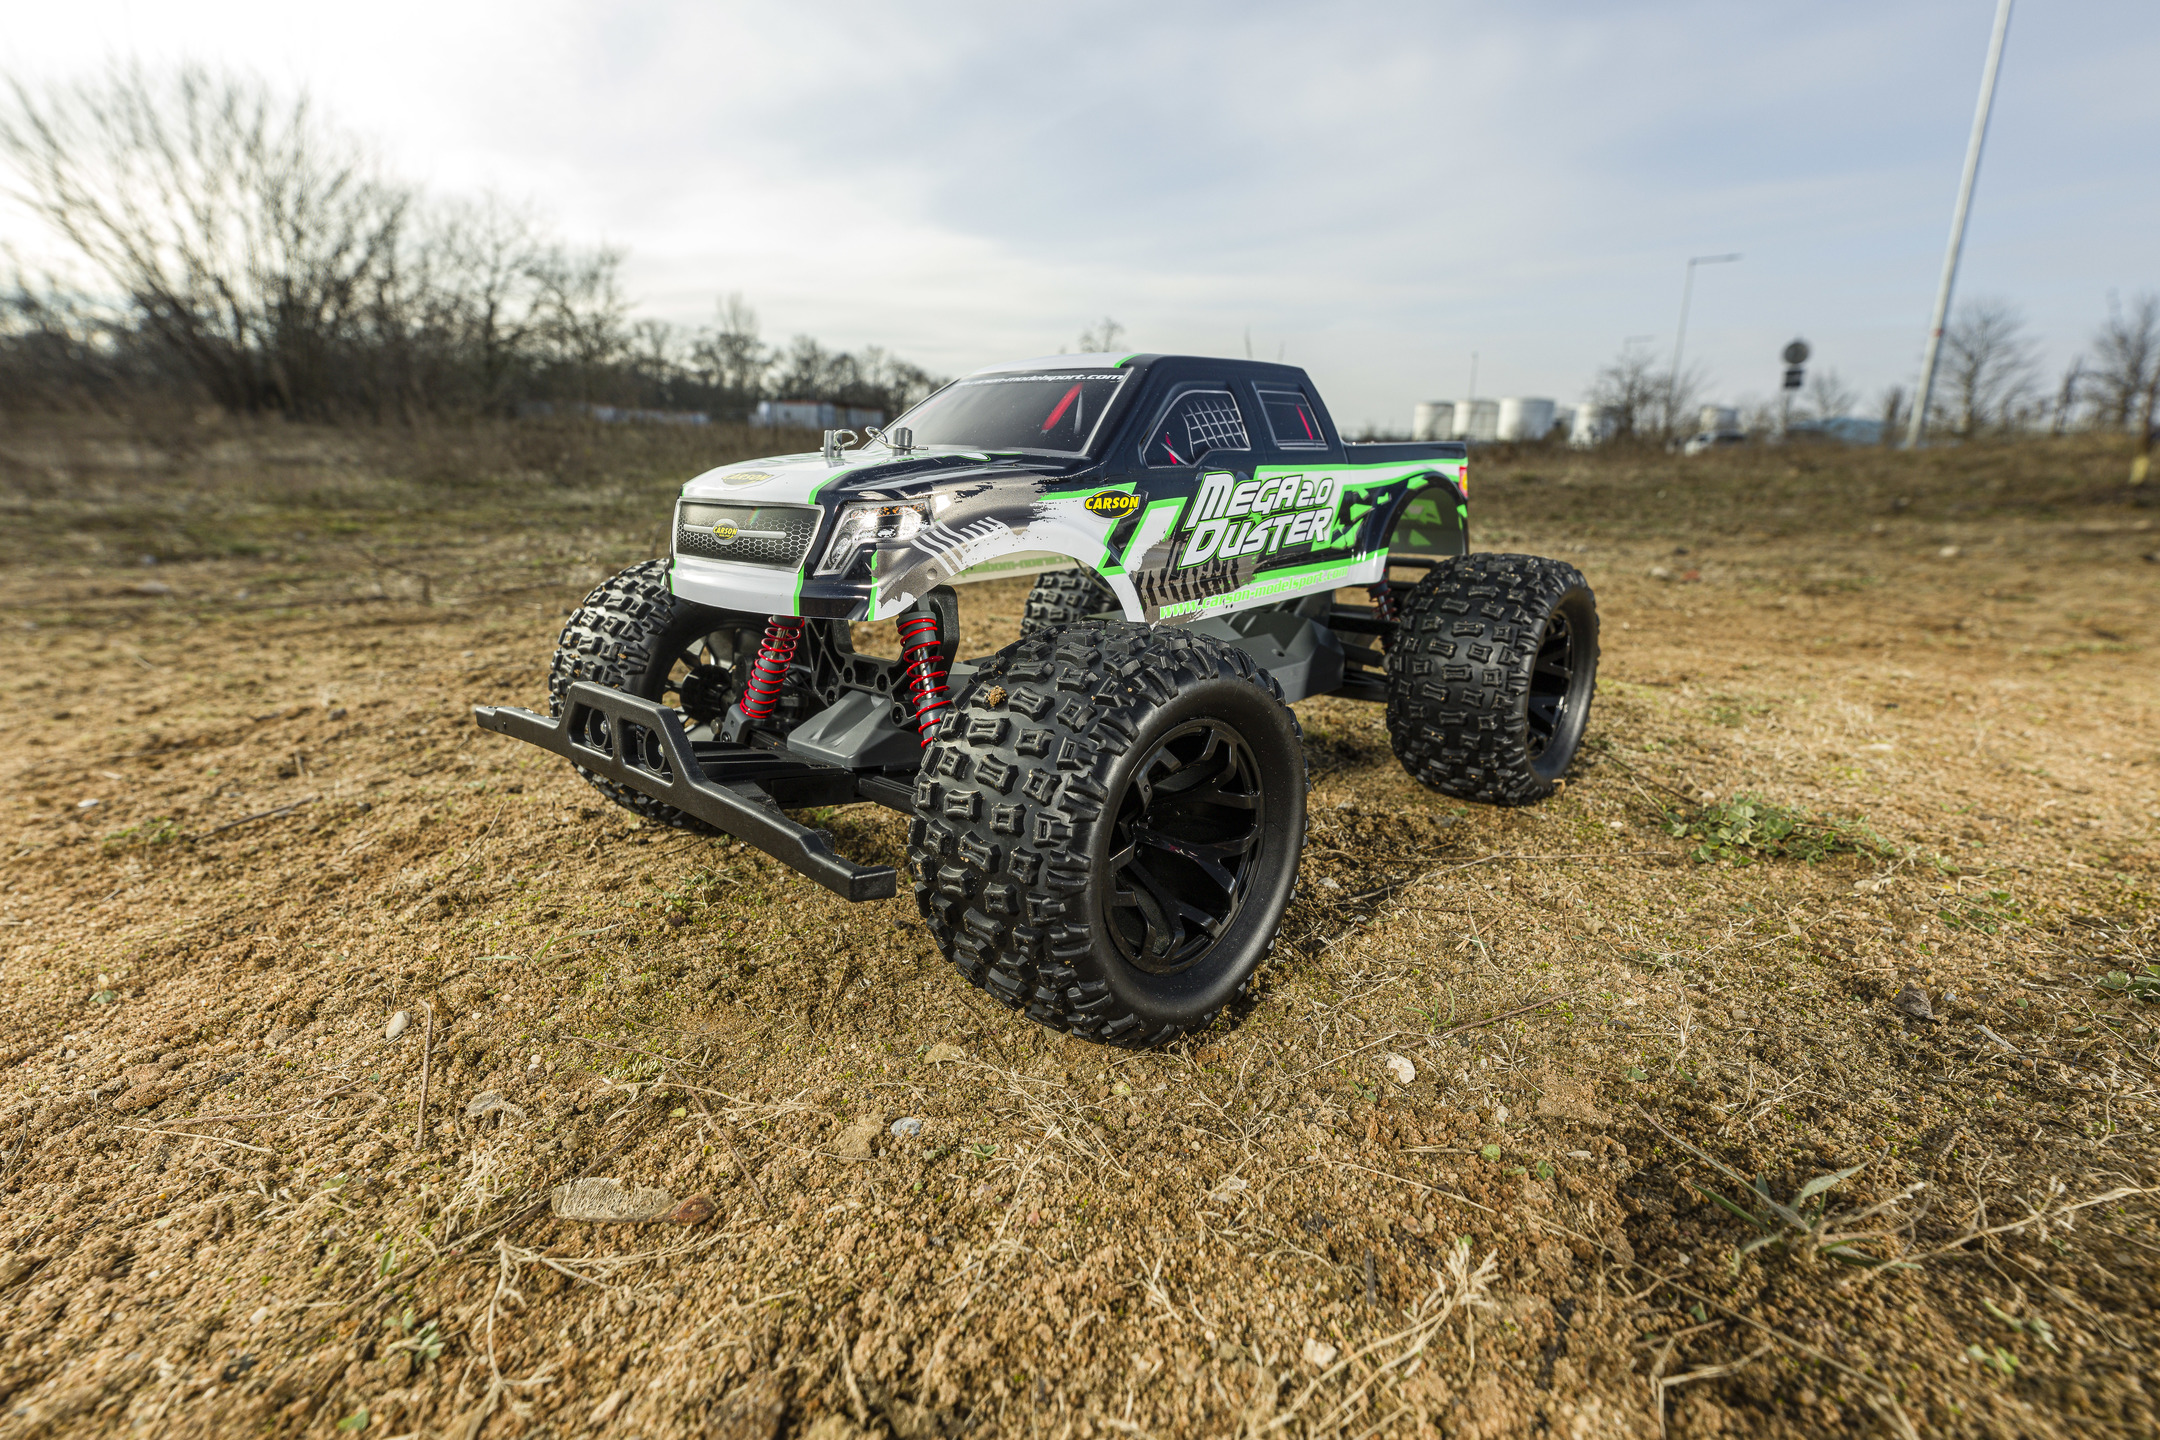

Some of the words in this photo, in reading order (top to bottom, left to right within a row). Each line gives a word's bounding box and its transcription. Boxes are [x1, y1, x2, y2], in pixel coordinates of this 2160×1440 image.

[1085, 497, 1139, 510] CARSON
[1183, 471, 1303, 531] MEGA
[1297, 478, 1333, 508] 2.0
[713, 526, 738, 536] CARSON
[1178, 508, 1333, 569] DUSTER
[1159, 566, 1348, 620] www.carson-modelsport.com
